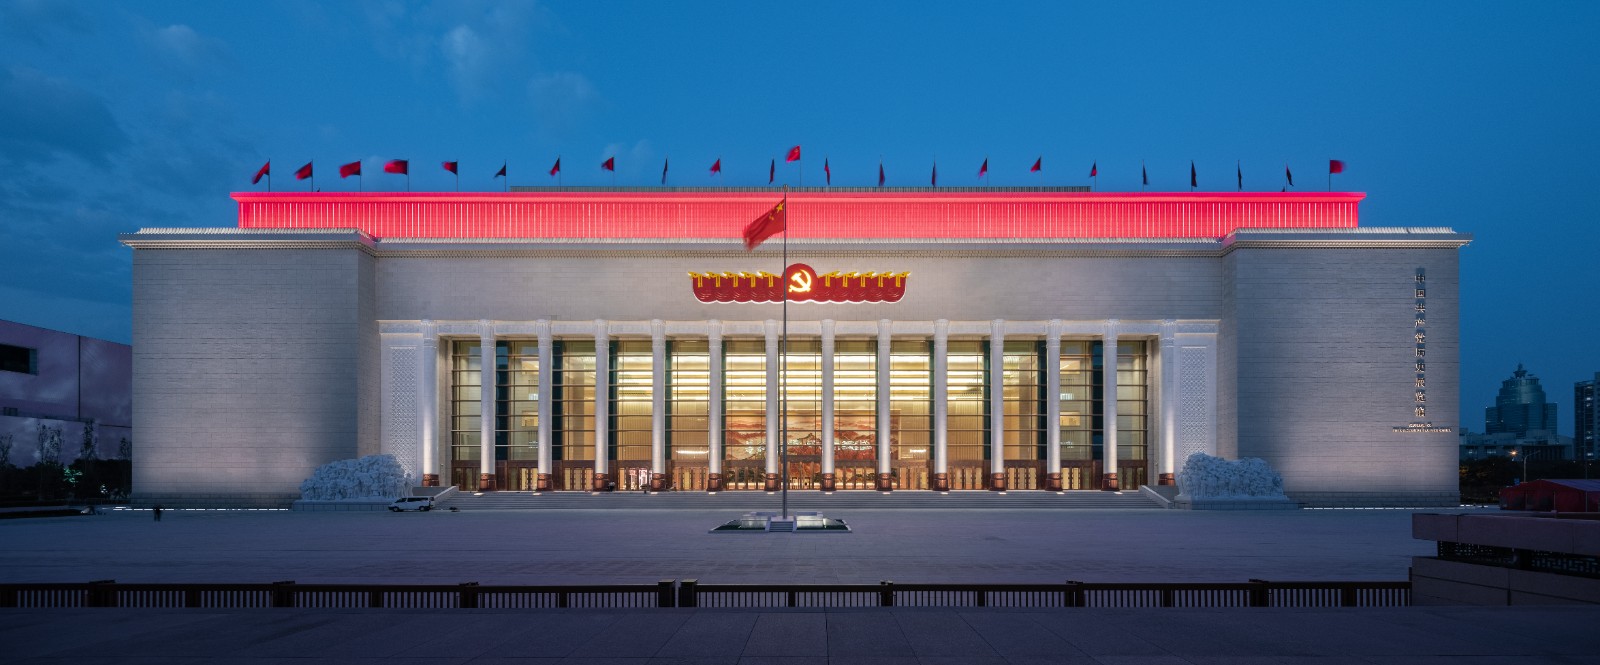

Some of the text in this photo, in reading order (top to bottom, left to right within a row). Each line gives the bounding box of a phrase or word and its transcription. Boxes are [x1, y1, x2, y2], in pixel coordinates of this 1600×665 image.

[1415, 273, 1426, 417] 中国共产党历史展览馆
